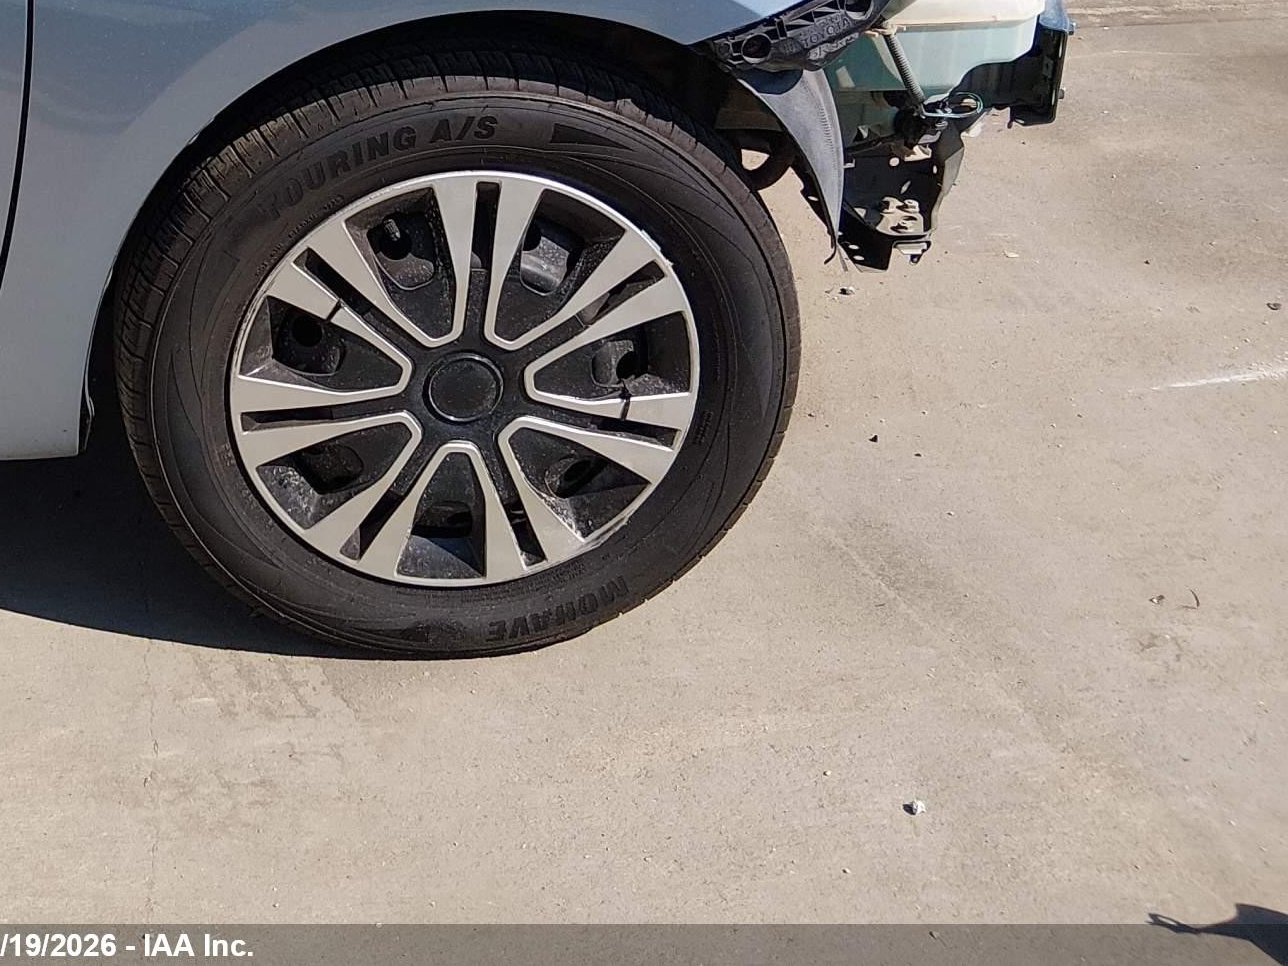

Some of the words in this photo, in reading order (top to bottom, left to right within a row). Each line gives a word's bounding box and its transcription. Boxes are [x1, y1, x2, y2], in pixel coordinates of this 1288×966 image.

[801, 15, 852, 49] TOYOTA
[262, 125, 417, 219] TOURING
[429, 115, 498, 145] A/S
[485, 575, 630, 643] MOHAVE
